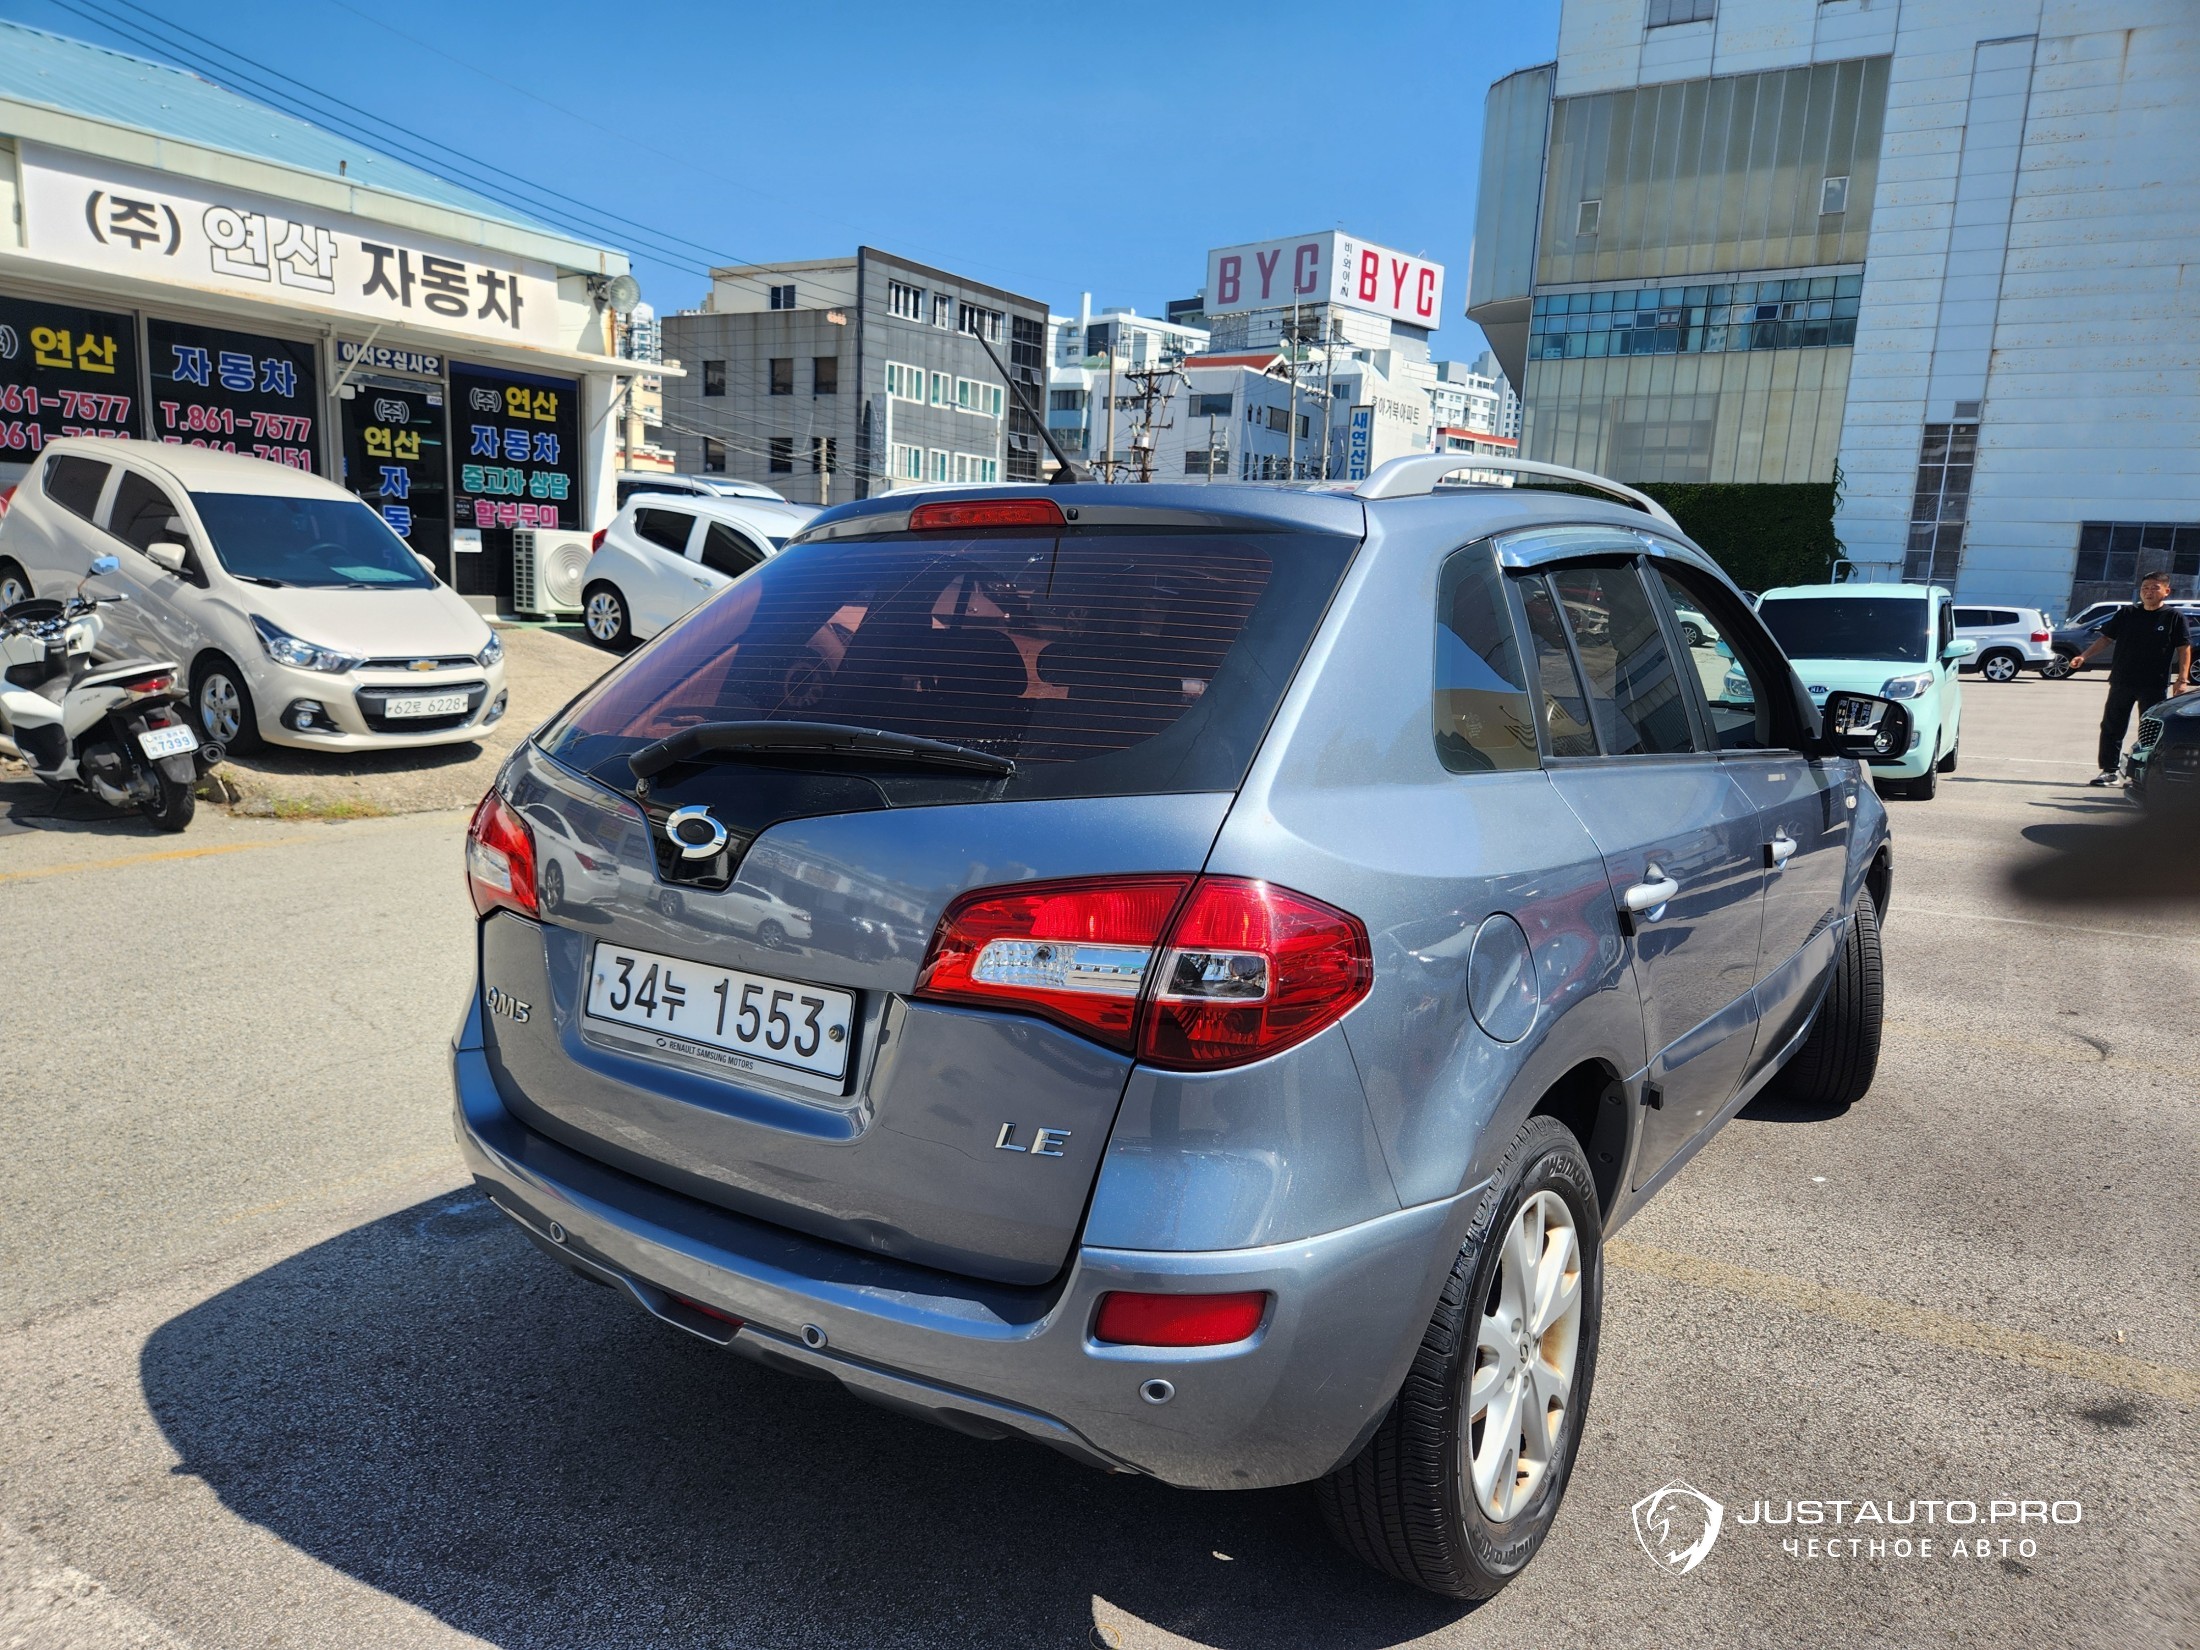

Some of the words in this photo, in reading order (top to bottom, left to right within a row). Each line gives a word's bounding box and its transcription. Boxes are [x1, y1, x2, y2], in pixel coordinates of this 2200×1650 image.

[85, 190, 181, 256] (주)
[202, 205, 338, 295] 연산
[361, 241, 524, 330] 자동차
[1218, 243, 1319, 305] BYC
[1358, 249, 1435, 318] BYC
[31, 326, 117, 374] 연산
[342, 343, 440, 376] 어서오십시오
[172, 344, 297, 398] 자동차
[0, 383, 131, 423] 61-7577
[374, 398, 410, 424] (주)
[469, 387, 502, 413] (주)
[505, 386, 558, 422] 연산
[160, 401, 312, 442] T.861-7577
[364, 426, 421, 460] 연산
[471, 424, 560, 465] 자동차
[462, 464, 526, 496] 중고차
[529, 471, 570, 500] 상담
[474, 499, 559, 529] 할부문의
[428, 697, 460, 712] 6228
[158, 736, 191, 751] 7399
[486, 986, 532, 1023] QM5
[609, 956, 686, 1022] 34누
[712, 977, 825, 1058] 1553
[669, 1041, 696, 1055] RENAULT
[697, 1048, 726, 1064] SAMSUNG
[727, 1056, 754, 1070] MOTORS
[995, 1122, 1072, 1157] LE
